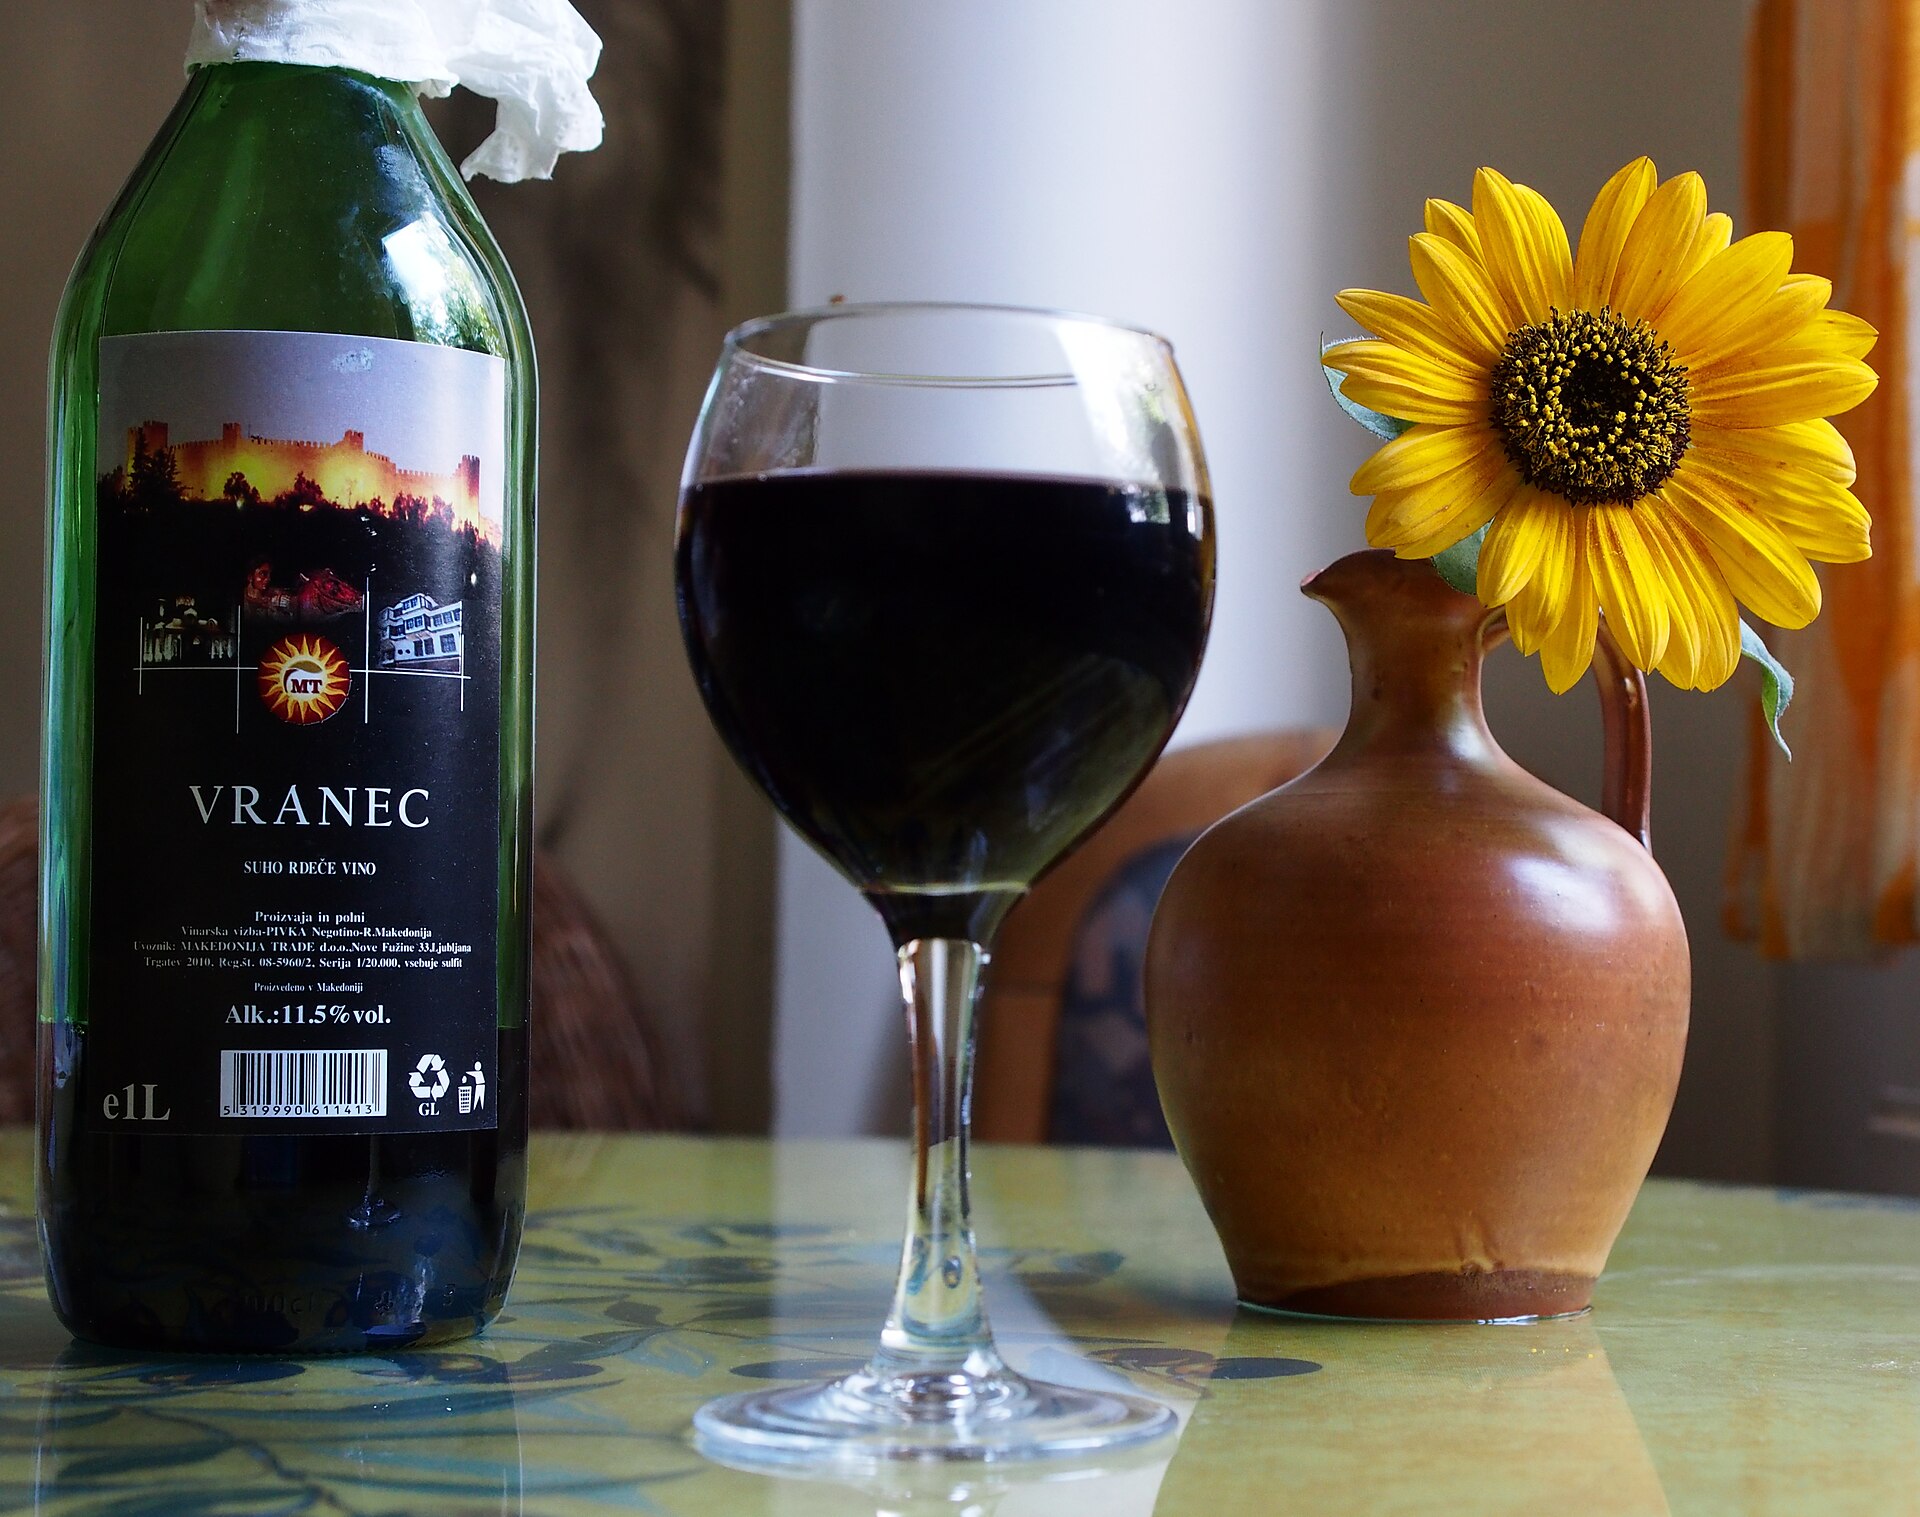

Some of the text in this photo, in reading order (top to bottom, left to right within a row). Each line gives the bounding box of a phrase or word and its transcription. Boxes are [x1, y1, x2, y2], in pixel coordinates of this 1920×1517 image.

[291, 679, 323, 694] MT
[189, 784, 431, 829] VRANEC
[243, 858, 377, 877] SUHO RDEČE VINO
[255, 911, 365, 925] Proizvaja in polni
[181, 926, 432, 939] Vinarska vizba-PIVKA Negotino-R.Makedonija
[134, 941, 176, 951] Uvoznik:
[181, 941, 265, 952] MAKEDONIJA
[271, 942, 315, 952] TRADE
[382, 942, 415, 953] Fužine
[144, 956, 182, 969] Trgatev
[319, 958, 351, 970] Serija
[404, 958, 439, 970] vsebuje
[441, 957, 463, 968] sulfit
[254, 982, 305, 992] Proizvedeno
[317, 982, 364, 994] Makedoniji
[418, 1102, 440, 1117] GL
